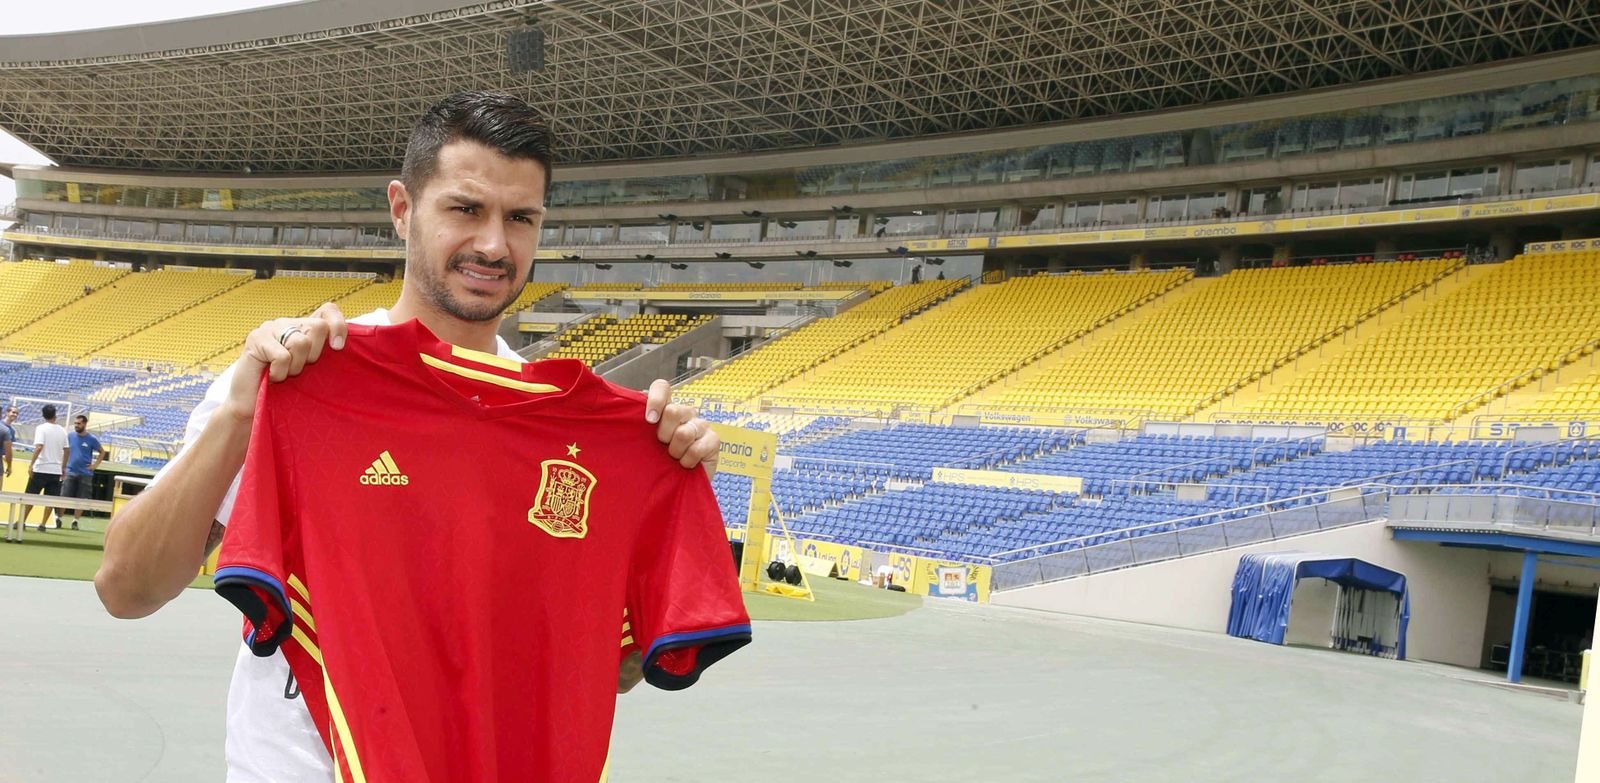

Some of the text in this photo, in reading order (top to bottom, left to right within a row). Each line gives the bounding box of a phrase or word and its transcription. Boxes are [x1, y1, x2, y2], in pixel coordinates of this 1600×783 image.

[984, 411, 1031, 423] Volkswagen
[719, 440, 753, 457] anaria
[359, 472, 409, 486] adidas
[943, 472, 966, 482] HPS
[1016, 478, 1040, 489] HPS
